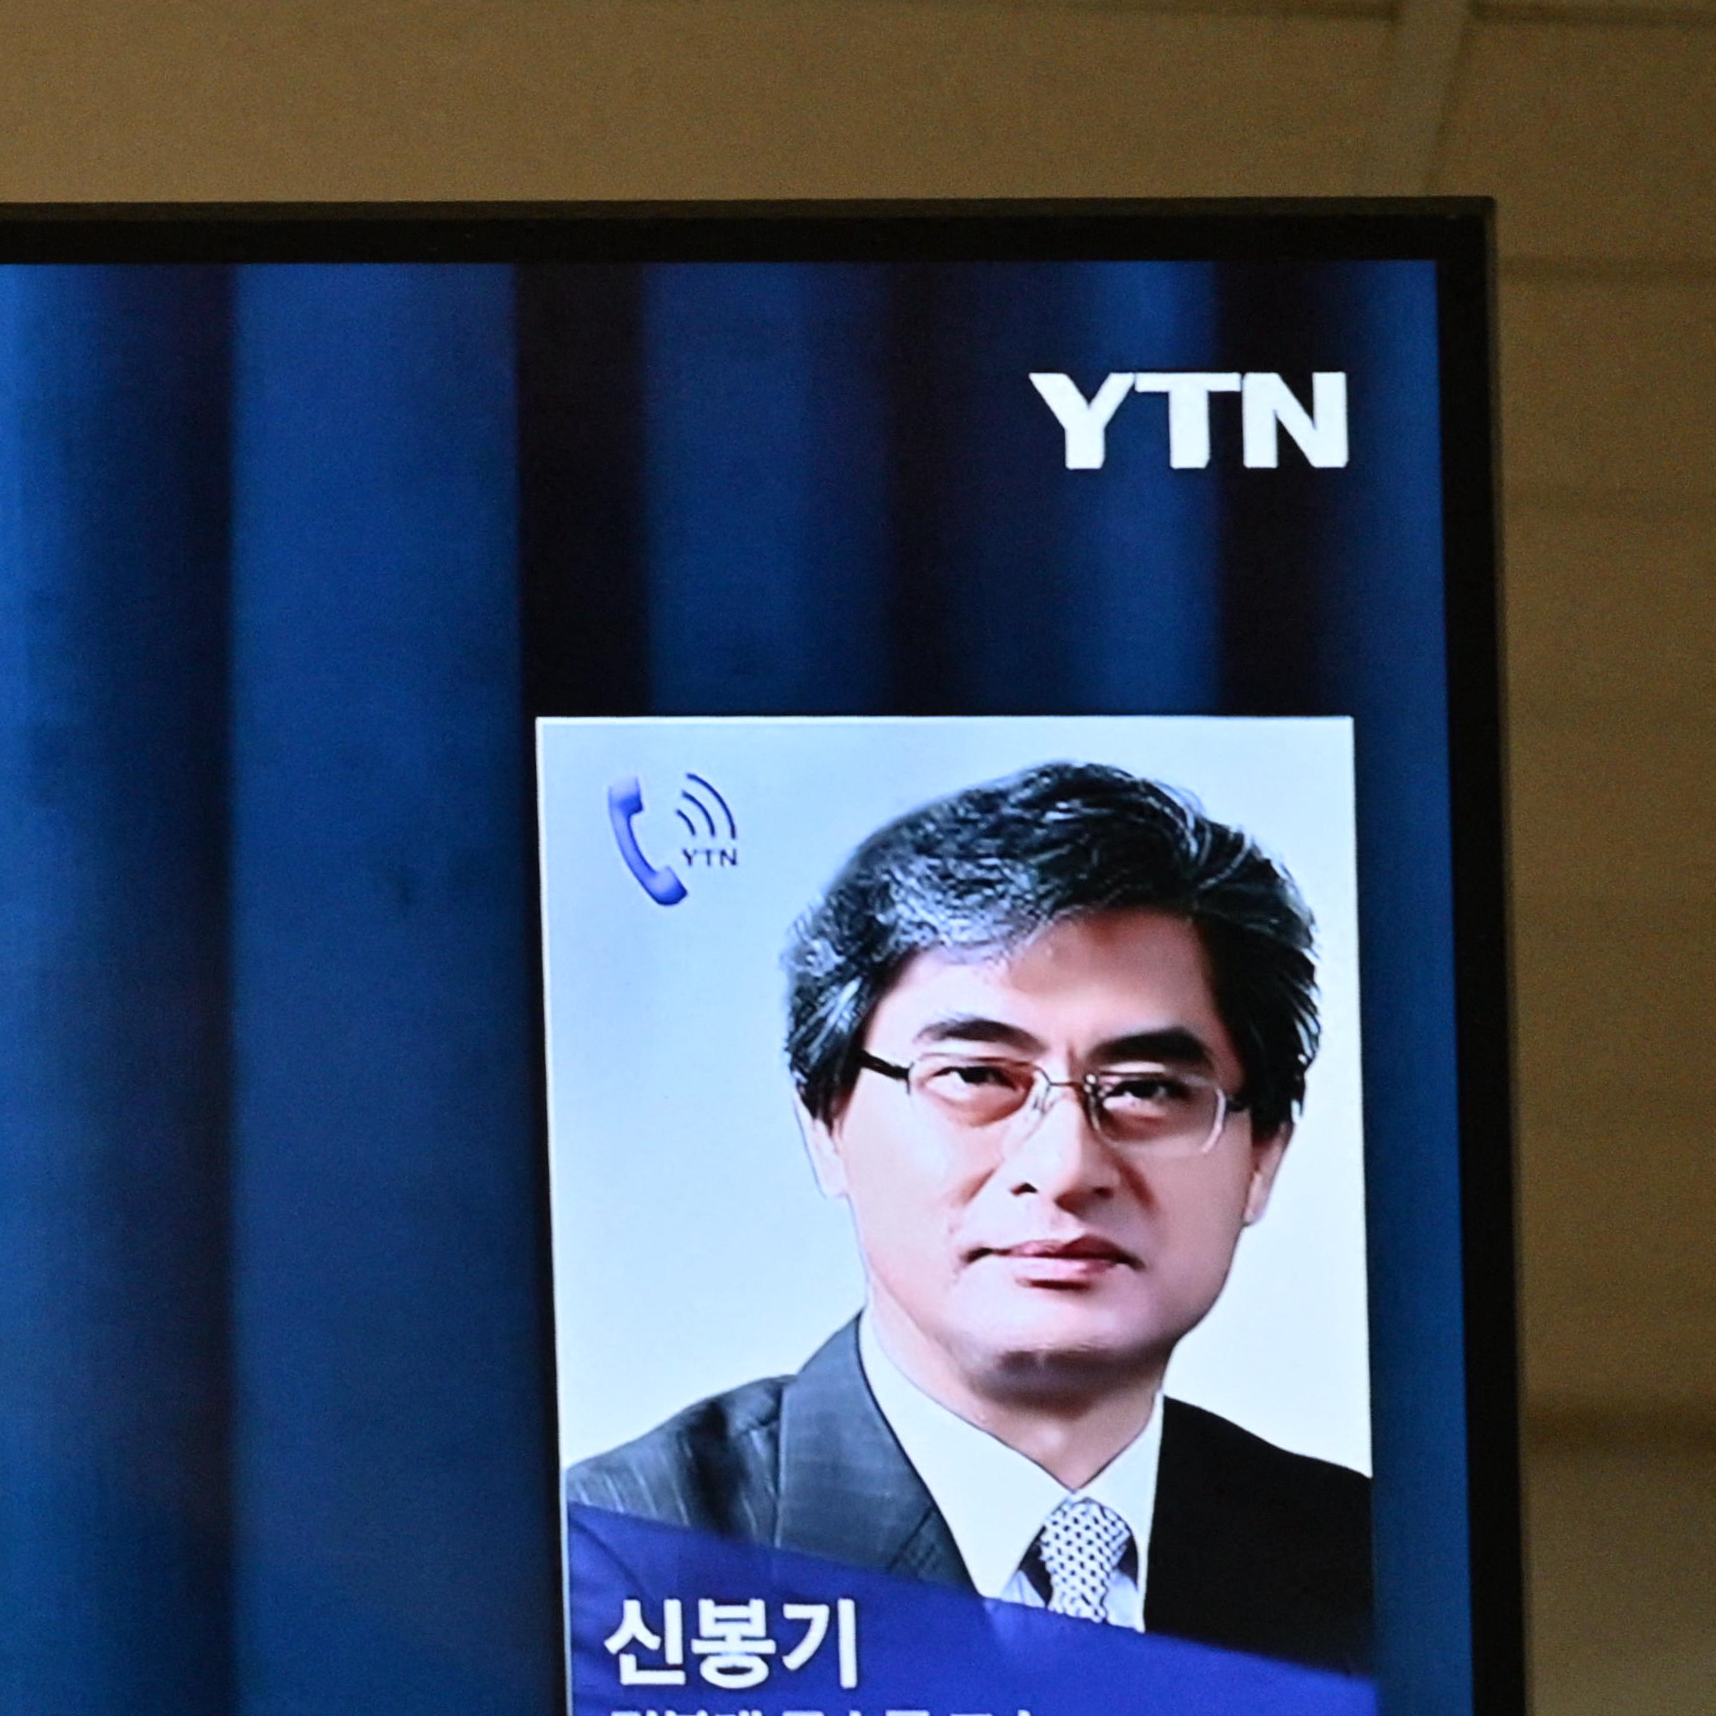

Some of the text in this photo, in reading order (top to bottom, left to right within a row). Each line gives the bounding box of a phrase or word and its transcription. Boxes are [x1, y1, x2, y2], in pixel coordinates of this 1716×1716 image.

[1029, 371, 1350, 470] YTN
[681, 847, 739, 868] YTN
[604, 1597, 858, 1690] 신봉기
